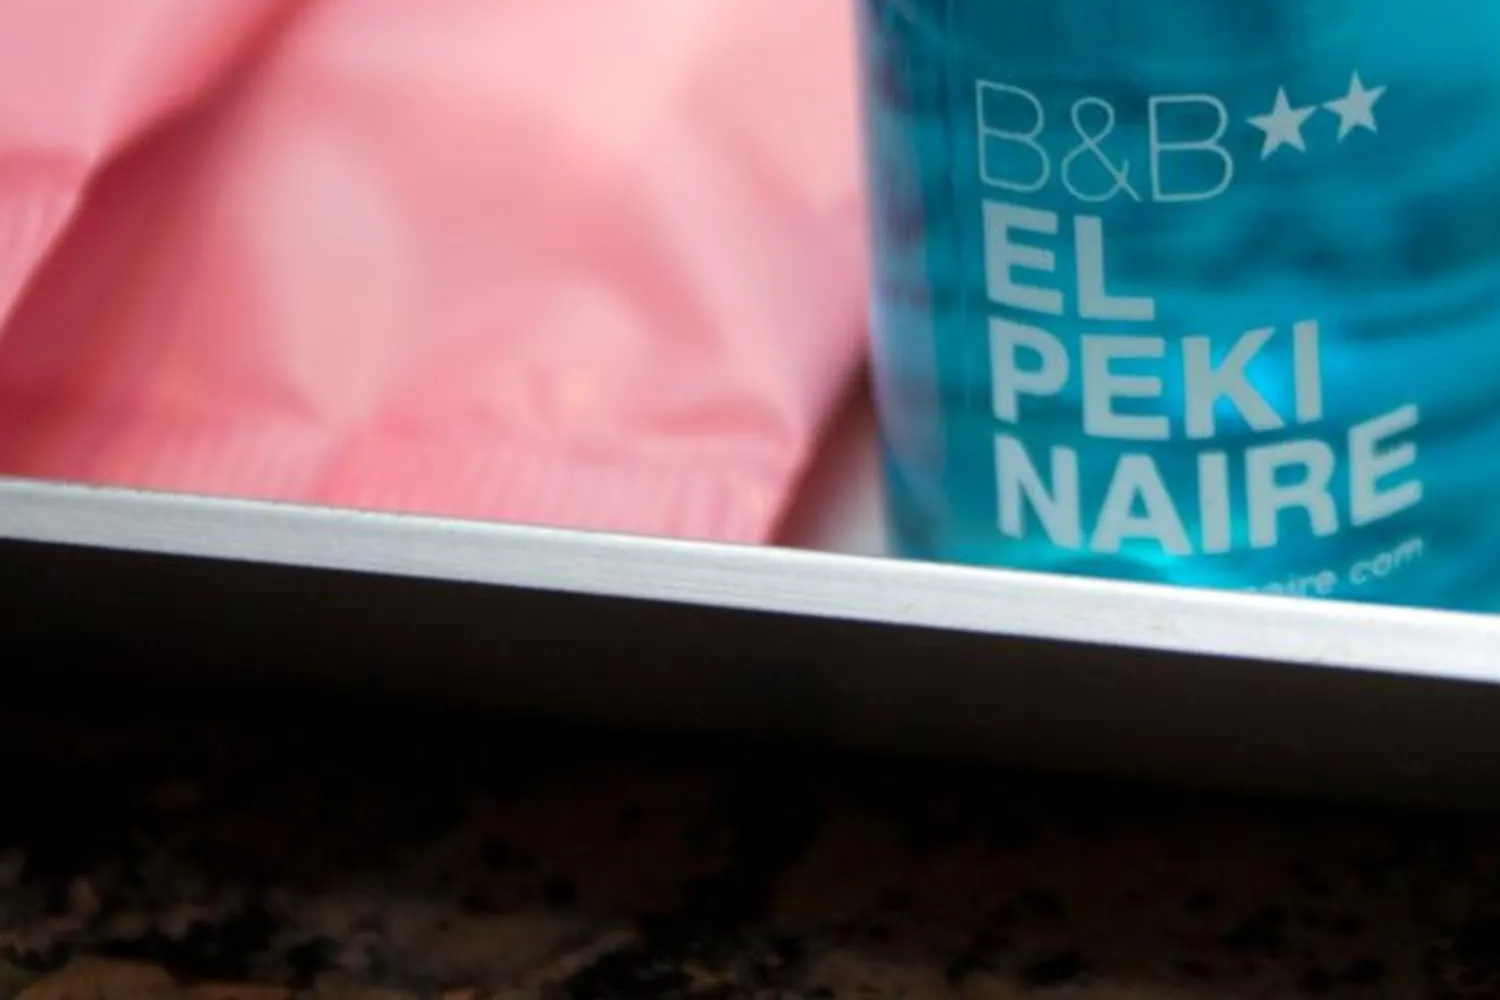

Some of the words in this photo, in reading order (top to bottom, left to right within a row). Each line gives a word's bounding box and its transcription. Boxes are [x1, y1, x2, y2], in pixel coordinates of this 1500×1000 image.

[975, 78, 1234, 203] B&B
[982, 198, 1155, 322] EL
[988, 315, 1323, 441] PEKI
[993, 404, 1424, 557] NAIRE
